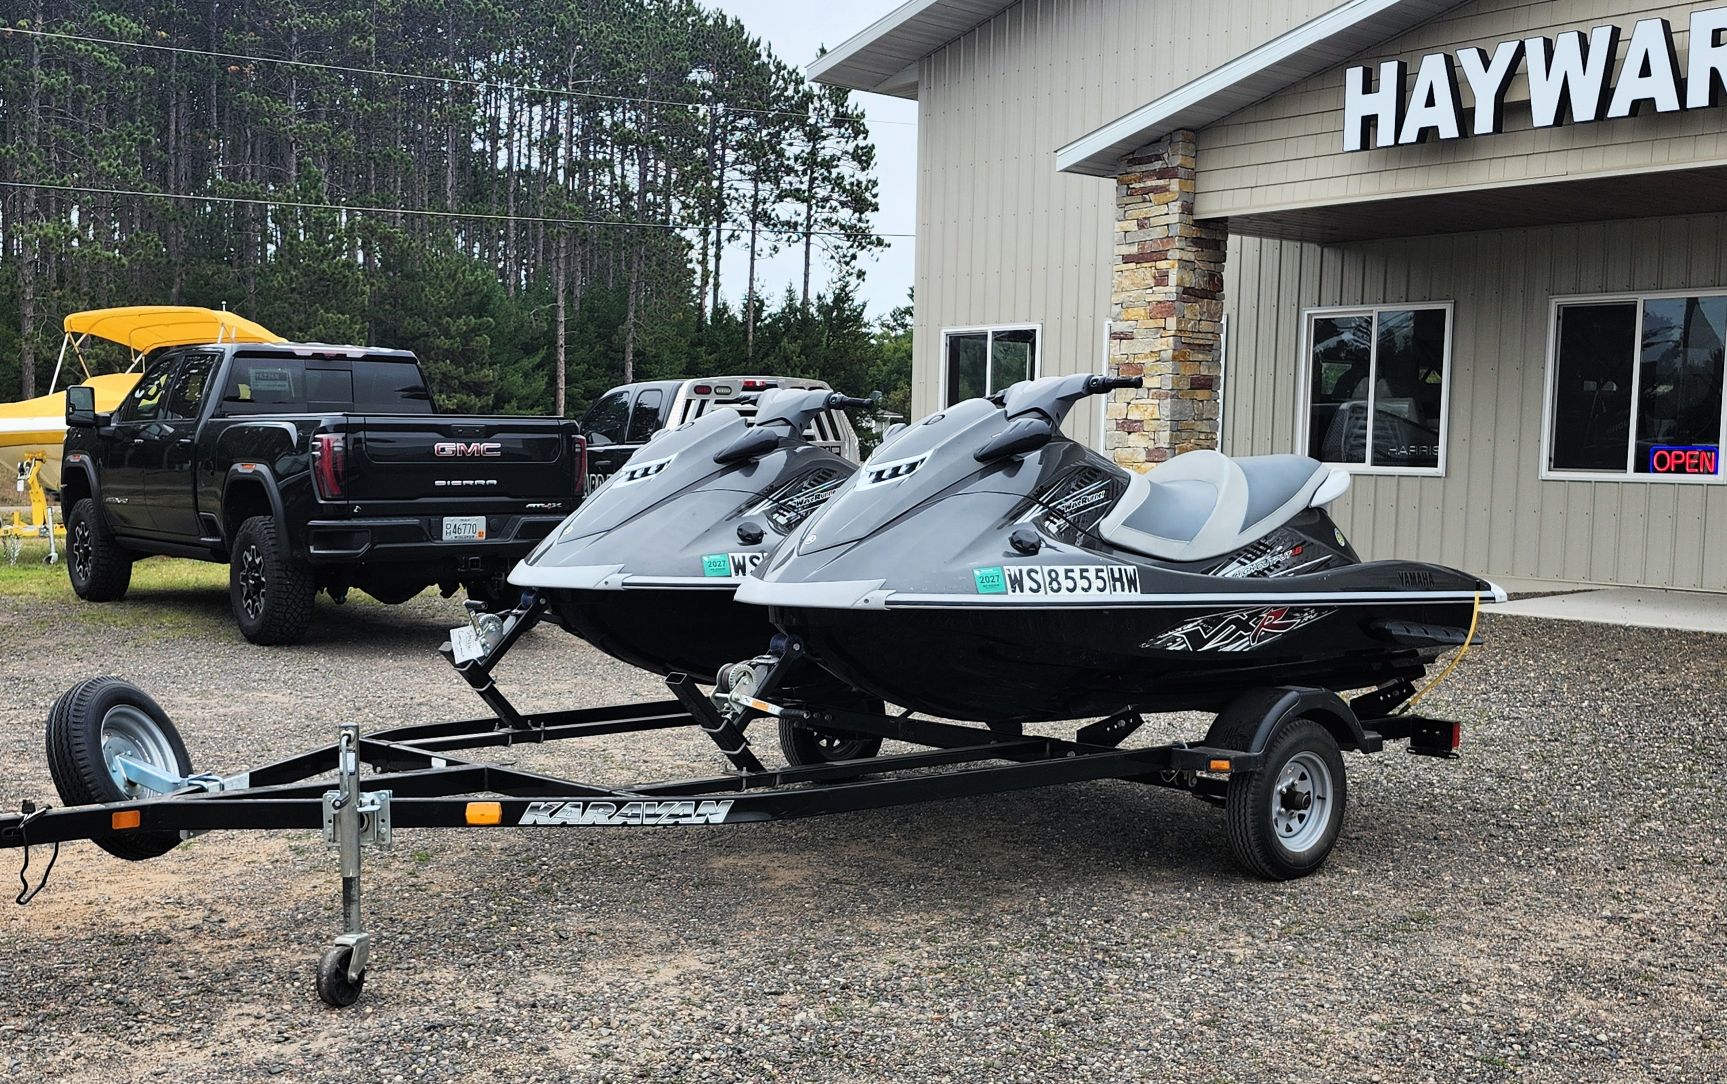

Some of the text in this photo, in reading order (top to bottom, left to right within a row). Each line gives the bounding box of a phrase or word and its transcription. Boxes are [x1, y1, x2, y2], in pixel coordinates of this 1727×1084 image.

[434, 442, 502, 457] GMC
[1388, 445, 1439, 456] HARRIS
[1653, 450, 1715, 473] OPEN
[452, 523, 477, 535] 46770
[707, 560, 726, 568] 2027
[979, 575, 1000, 584] 2027
[1007, 567, 1141, 593] WS 8555 HW
[1397, 570, 1435, 588] YAMAHA
[518, 800, 734, 824] KARAVAN
